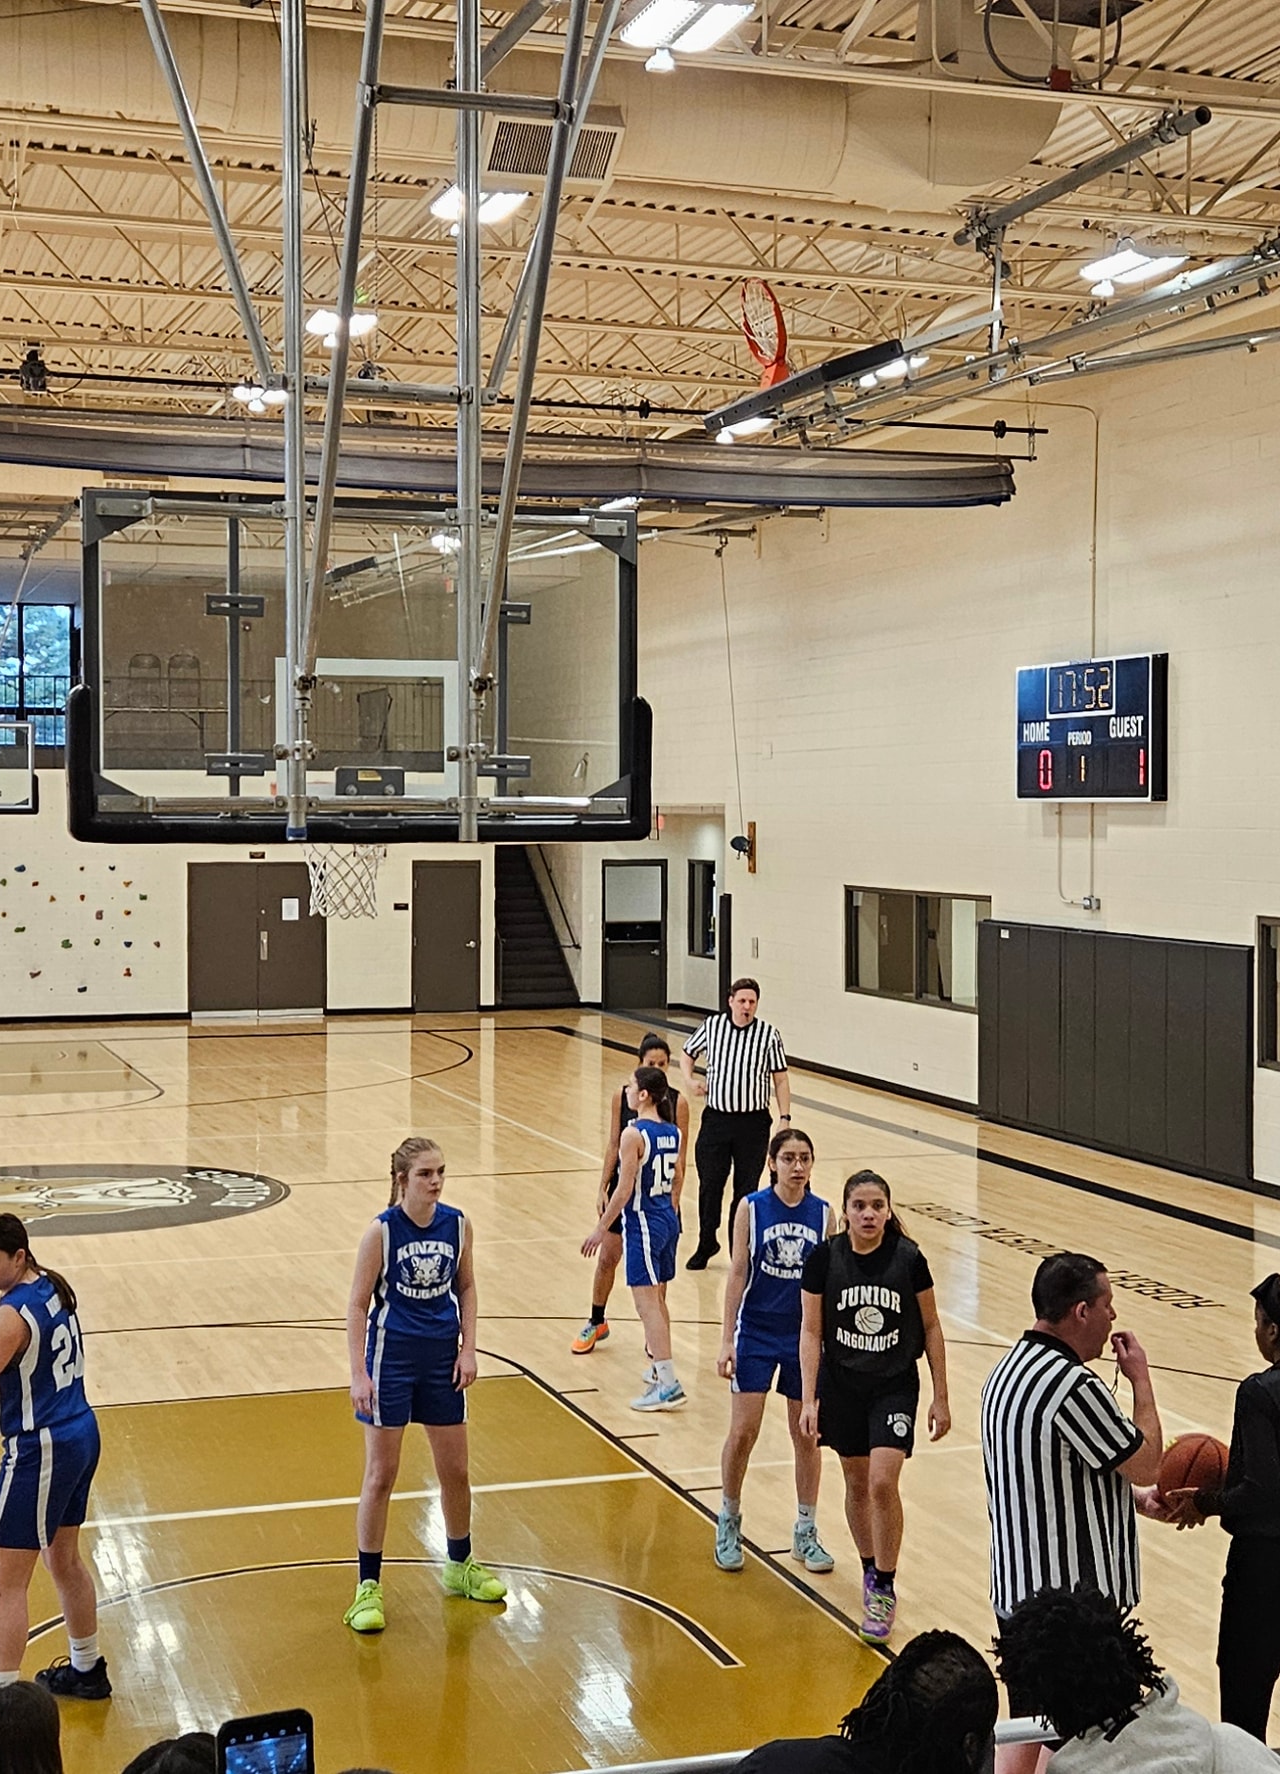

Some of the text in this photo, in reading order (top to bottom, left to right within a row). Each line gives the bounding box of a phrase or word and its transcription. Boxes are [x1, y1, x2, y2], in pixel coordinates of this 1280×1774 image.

[1057, 666, 1111, 709] 17:52
[1023, 715, 1144, 746] HOME PERIOD GUEST
[1039, 748, 1145, 790] 0 1 1
[650, 1153, 679, 1198] 15
[763, 1222, 818, 1245] KINZIE
[396, 1241, 455, 1264] KINZIE
[761, 1260, 803, 1280] COUGA
[836, 1285, 902, 1314] JUNIOR
[836, 1327, 899, 1352] ARGONAUTS
